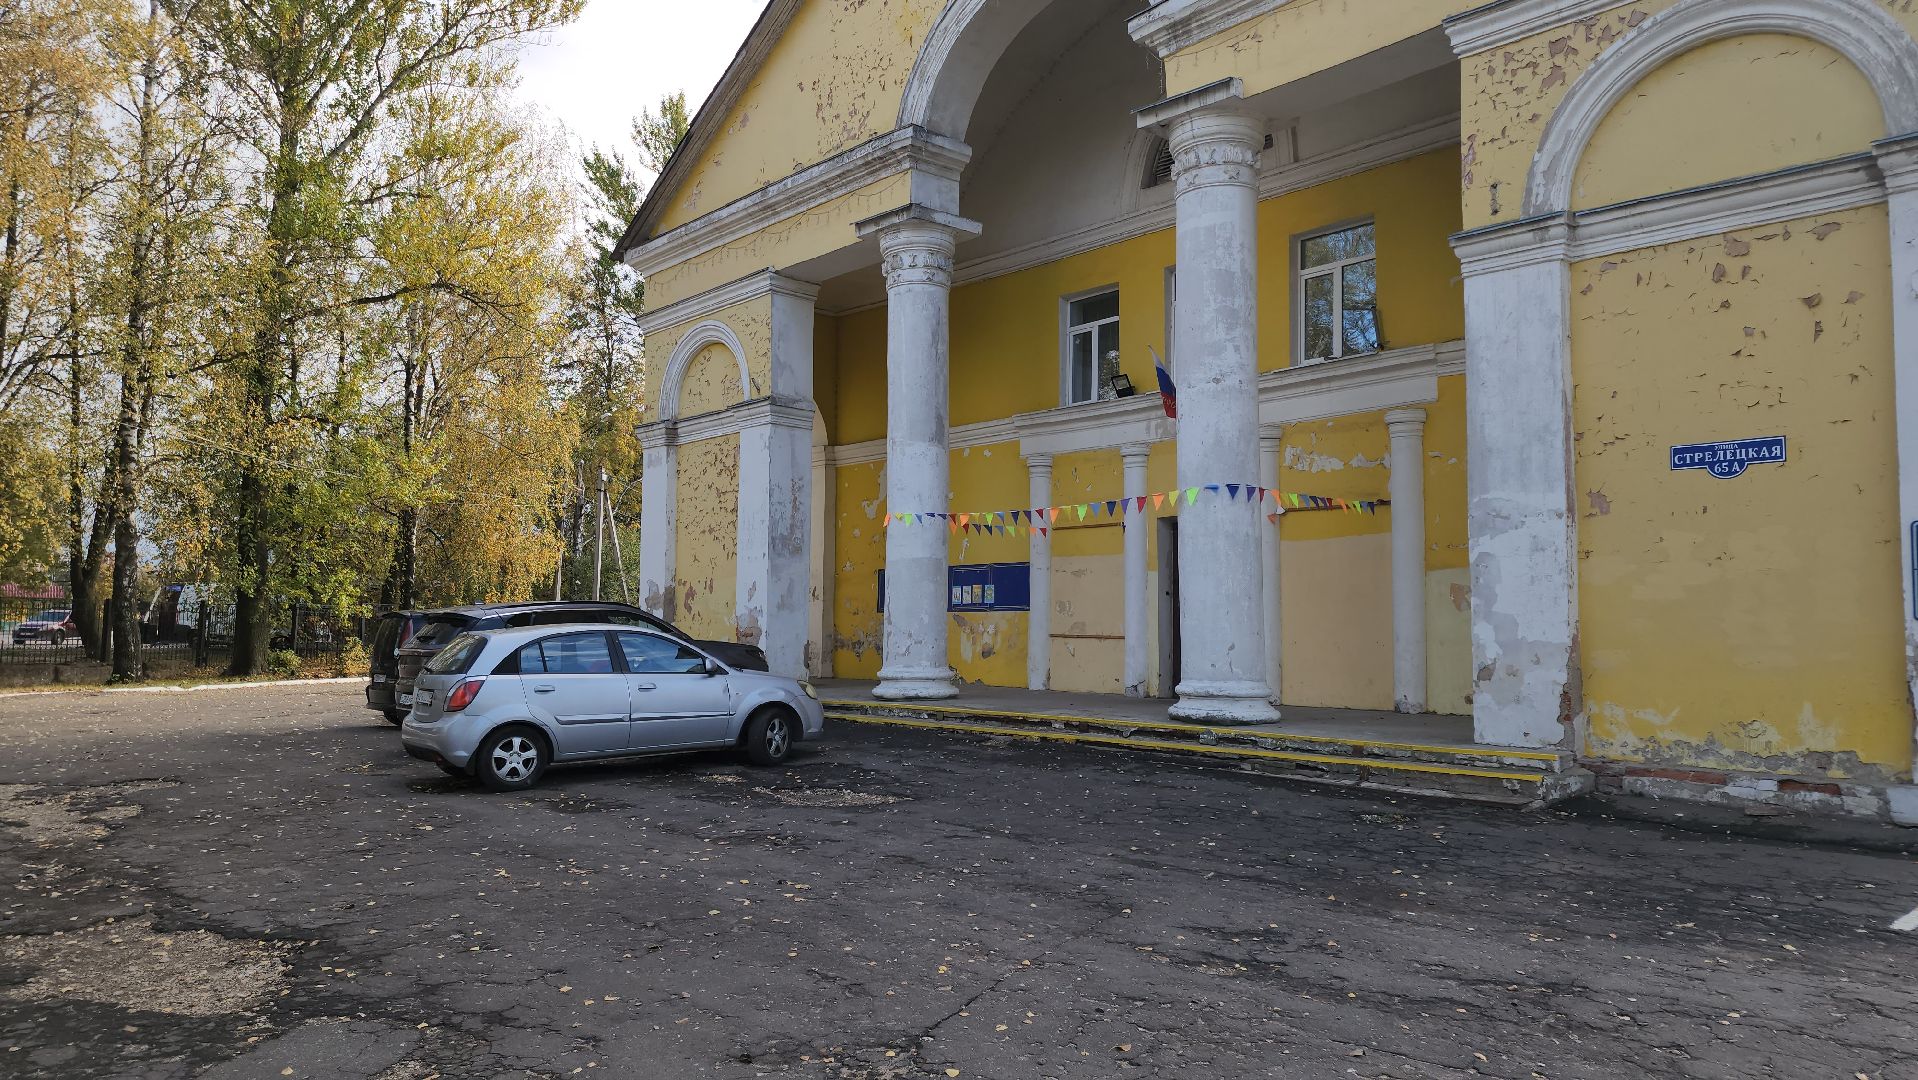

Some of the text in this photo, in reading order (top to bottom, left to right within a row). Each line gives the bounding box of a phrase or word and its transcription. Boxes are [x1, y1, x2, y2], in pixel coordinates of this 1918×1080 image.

[1674, 445, 1781, 465] СТРЕЛЕЦКАЯ
[1714, 461, 1740, 474] 65 А
